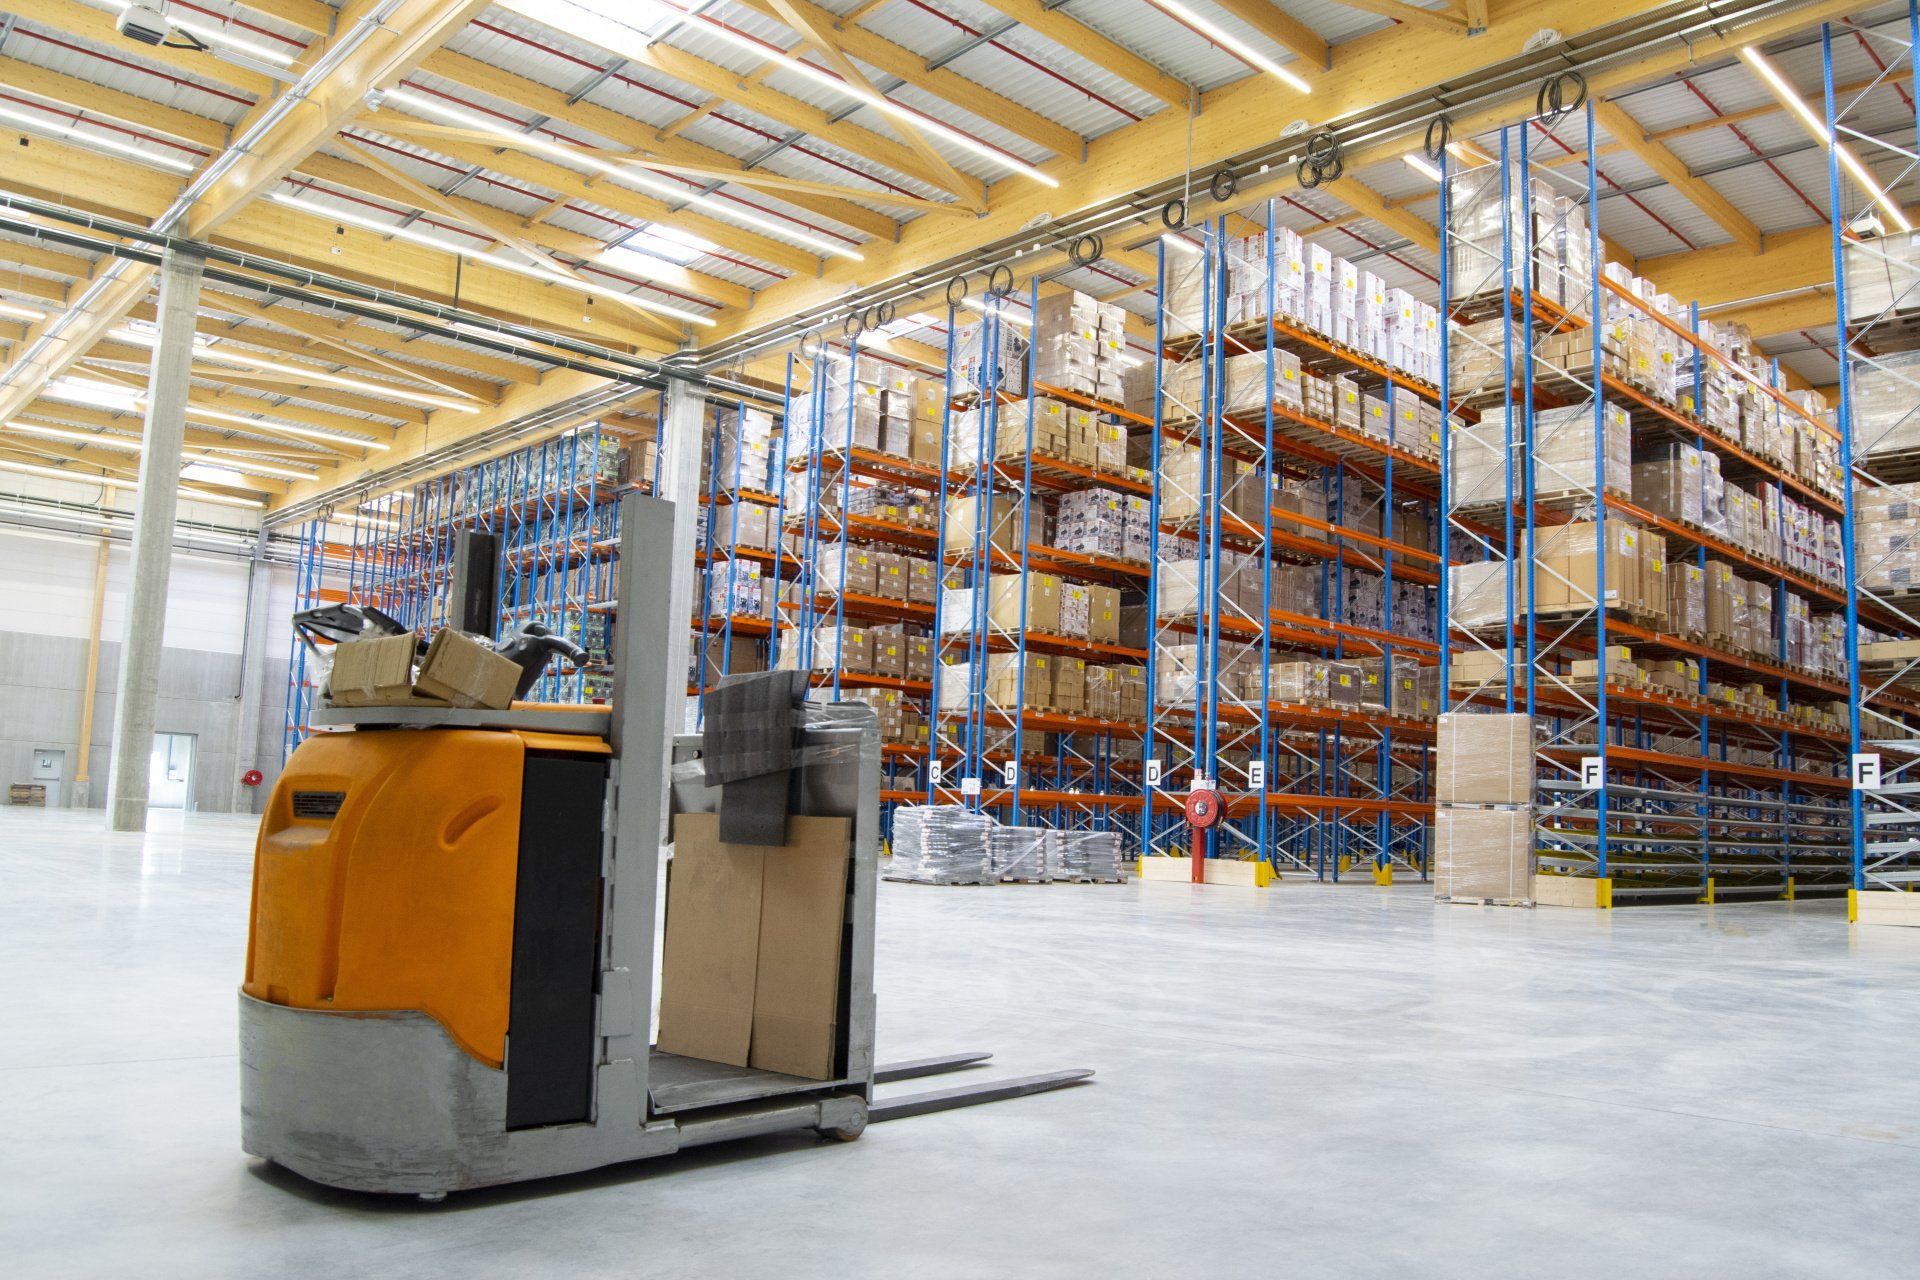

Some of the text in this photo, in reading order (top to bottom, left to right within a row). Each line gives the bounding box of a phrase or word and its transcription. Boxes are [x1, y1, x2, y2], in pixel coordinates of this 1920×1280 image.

[931, 767, 939, 779] C
[1007, 767, 1015, 780] D
[1148, 767, 1158, 781] D
[1252, 768, 1261, 784] E
[1586, 766, 1598, 784] F
[1859, 763, 1874, 783] F
